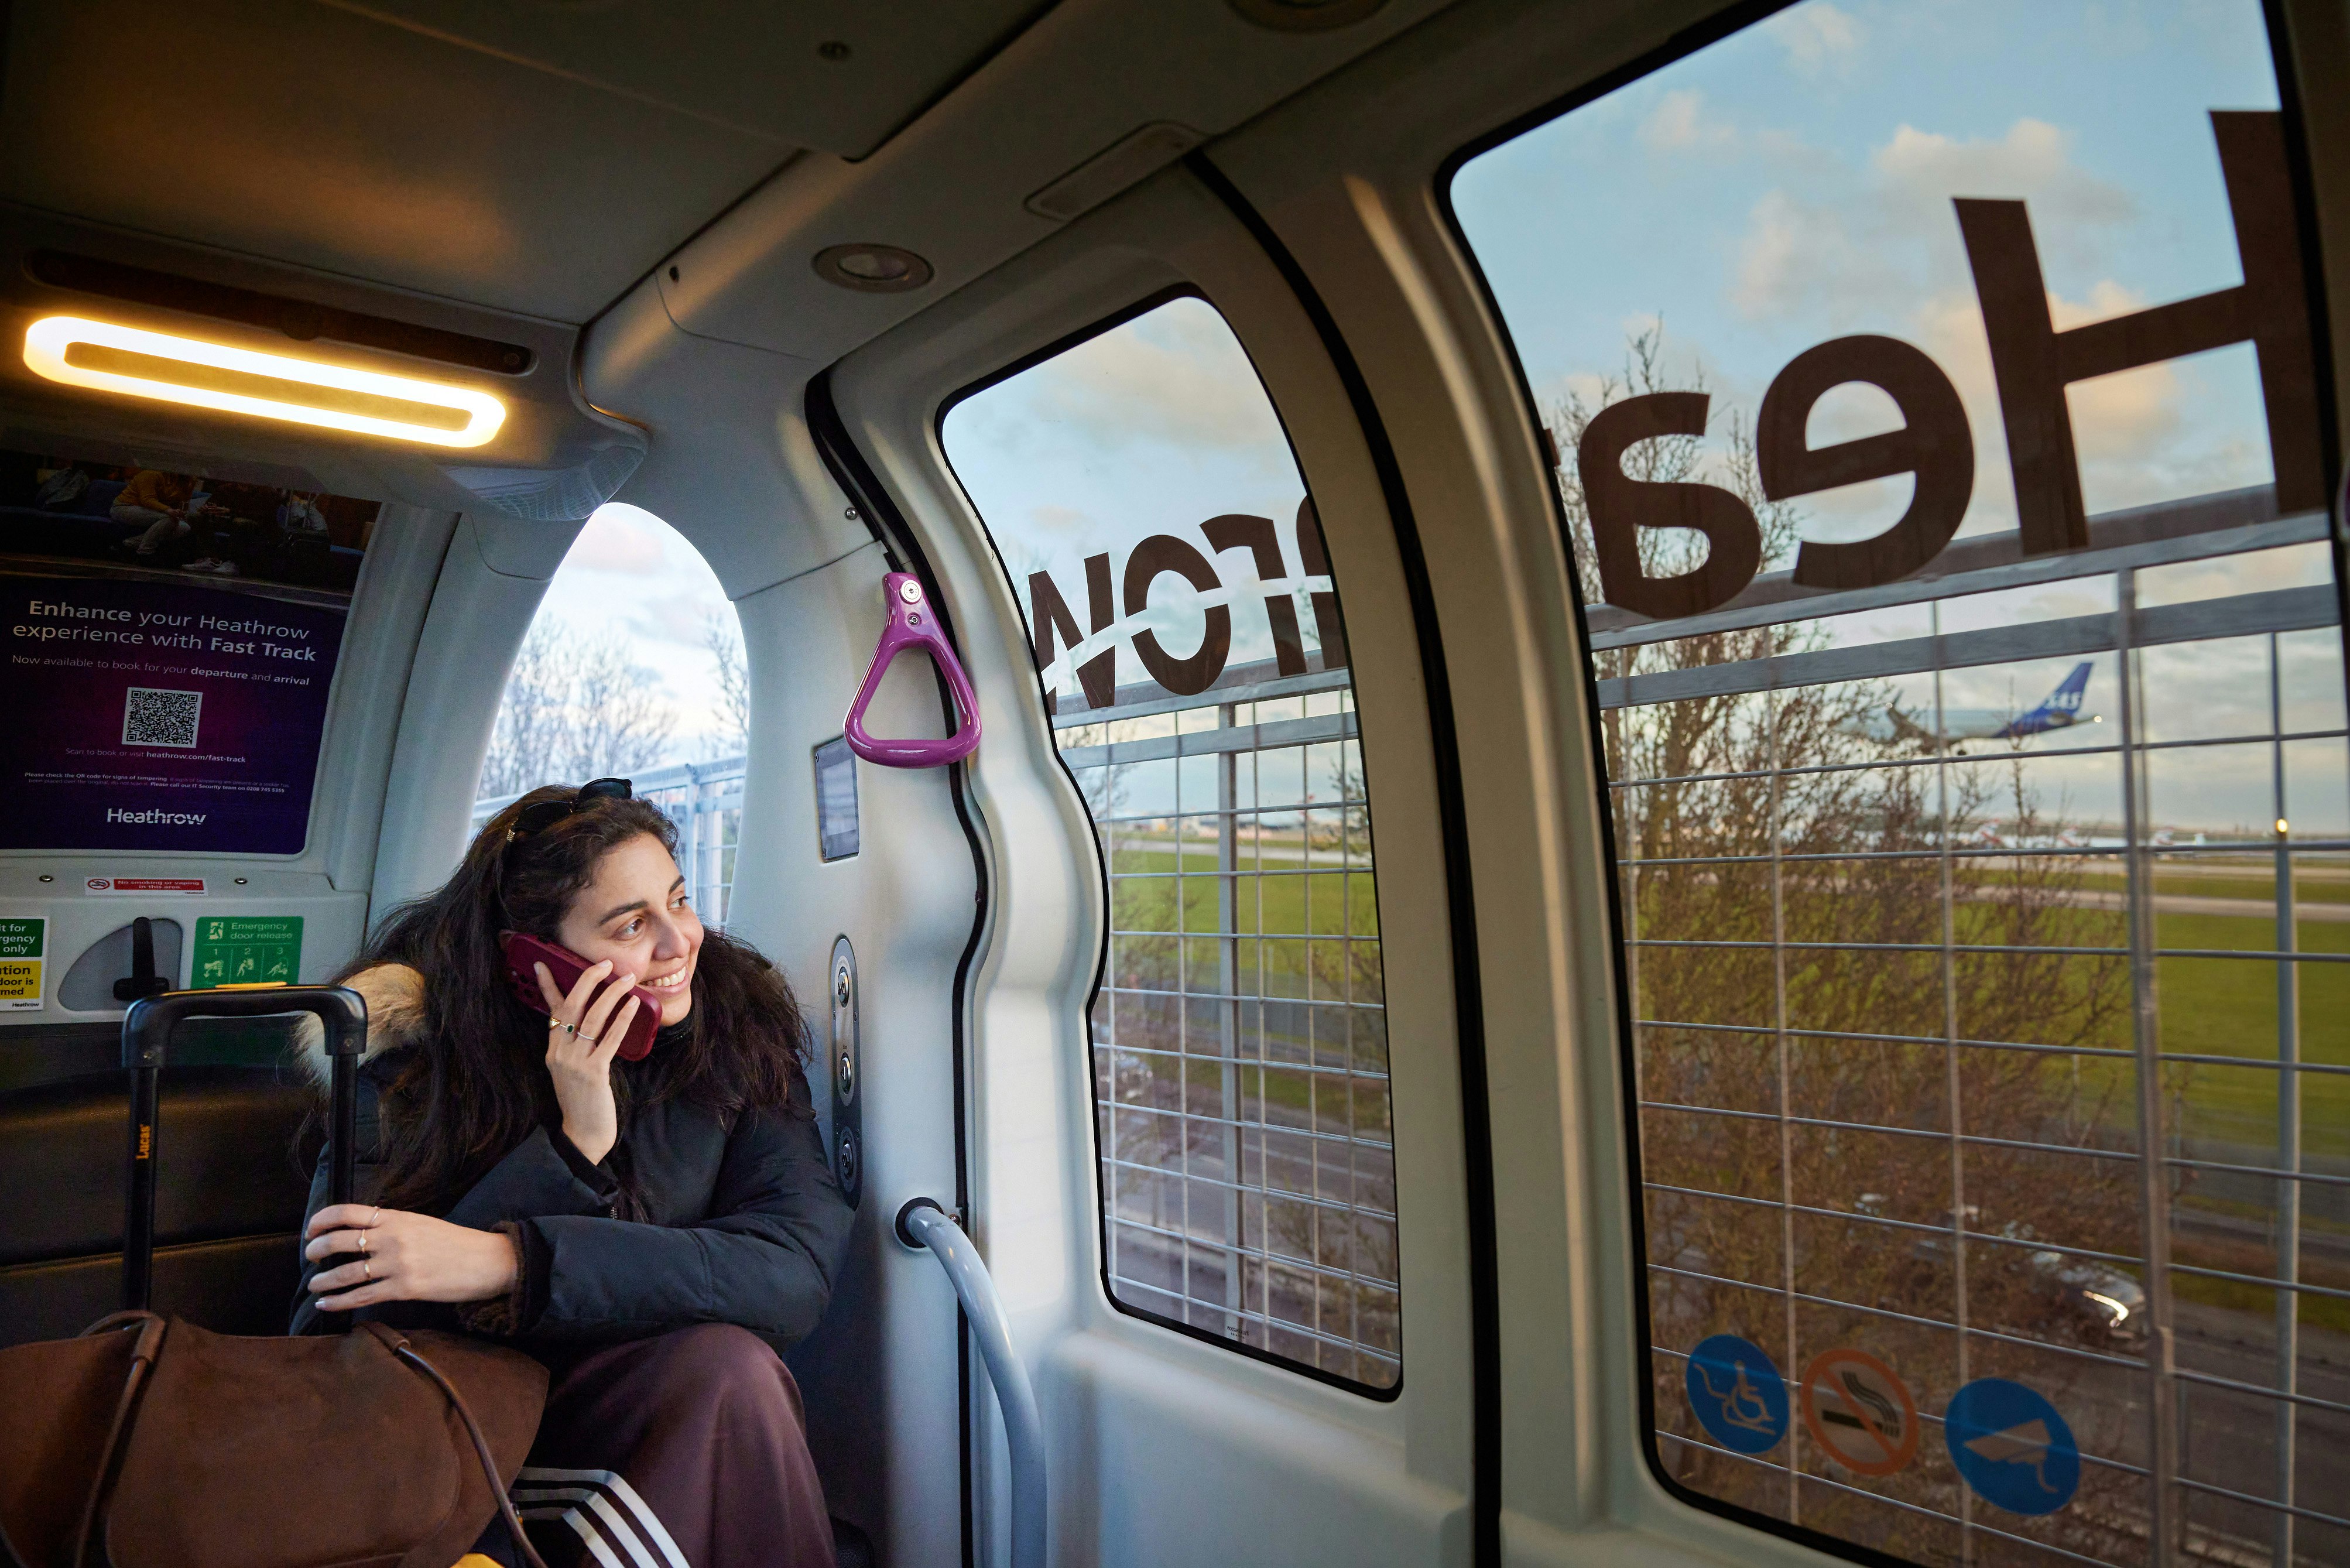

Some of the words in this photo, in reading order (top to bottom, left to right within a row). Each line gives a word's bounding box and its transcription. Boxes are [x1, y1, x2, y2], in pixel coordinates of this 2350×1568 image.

[29, 600, 132, 621] Enhance
[138, 612, 192, 626] your
[199, 615, 310, 639] Heathrow
[13, 625, 143, 644] experience
[152, 634, 201, 649] with
[211, 637, 255, 655] Fast
[262, 642, 316, 661] Track
[12, 655, 40, 664] Now
[43, 658, 93, 667] available
[97, 660, 108, 668] to
[112, 660, 140, 670] book
[145, 662, 159, 672] for
[163, 666, 188, 674] your
[190, 667, 248, 680] departure
[251, 673, 270, 682] and
[273, 676, 310, 686] arrival
[146, 751, 246, 762] heathrow.com/fast-track
[107, 808, 207, 825] Heathrow
[231, 922, 287, 932] Emergency
[3, 944, 28, 954] only
[0, 965, 30, 975] tion
[0, 987, 24, 995] med
[136, 1125, 150, 1159] Lucas
